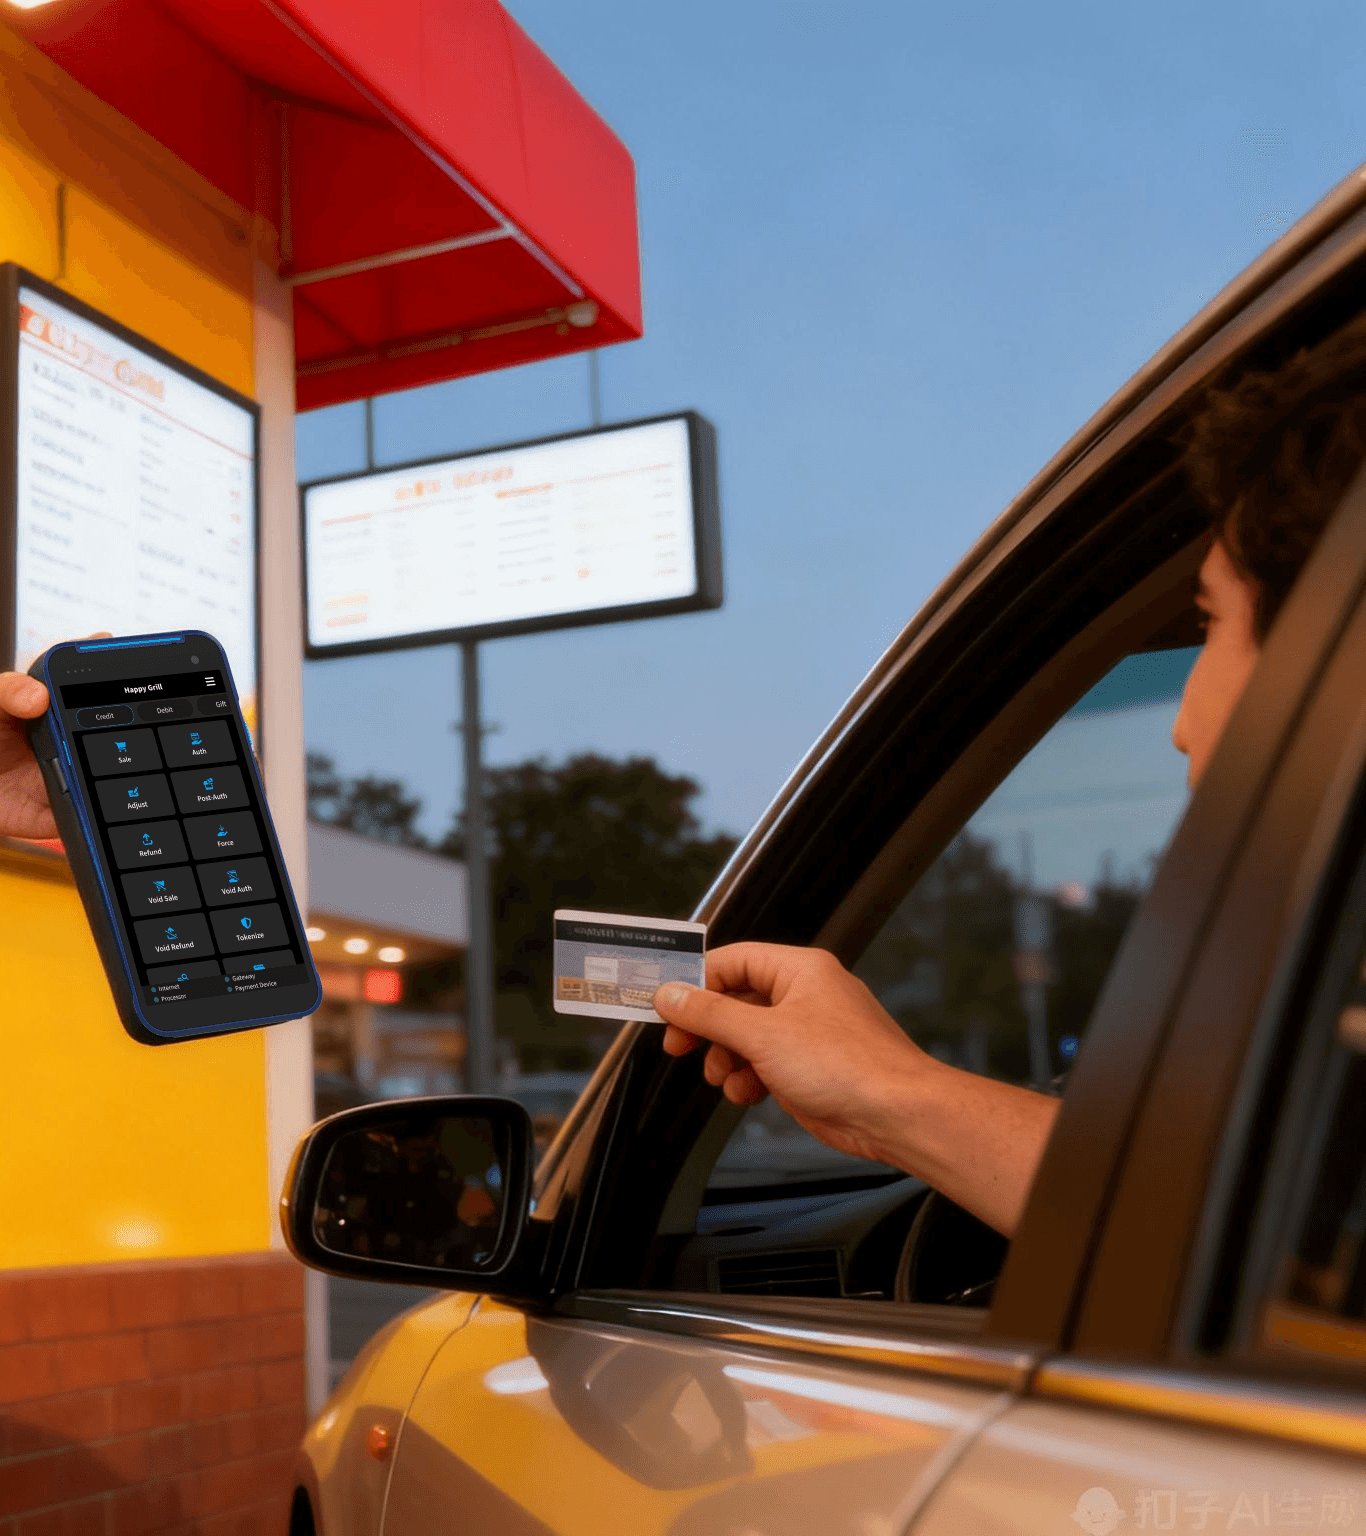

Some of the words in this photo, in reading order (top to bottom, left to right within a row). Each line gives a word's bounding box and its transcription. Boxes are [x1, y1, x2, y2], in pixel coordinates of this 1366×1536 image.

[124, 686, 147, 694] Happy
[147, 683, 163, 692] Grill
[215, 700, 228, 708] Gift
[156, 706, 174, 714] Debit
[95, 712, 115, 721] Credit
[192, 748, 207, 756] Auth
[118, 756, 132, 764] Sale
[197, 792, 228, 802] Post-Auth
[127, 801, 149, 810] Adjust
[217, 840, 234, 848] Force
[139, 848, 162, 857] Refund
[220, 887, 236, 895] Void
[237, 885, 253, 893] Auth
[147, 895, 164, 904] Void
[164, 894, 179, 902] Sale
[235, 931, 265, 941] Tokenize
[154, 944, 170, 953] Void
[170, 941, 195, 950] Refund
[231, 973, 256, 982] Gateway
[158, 983, 181, 992] Internet
[234, 983, 259, 992] Payment
[259, 980, 277, 989] Device
